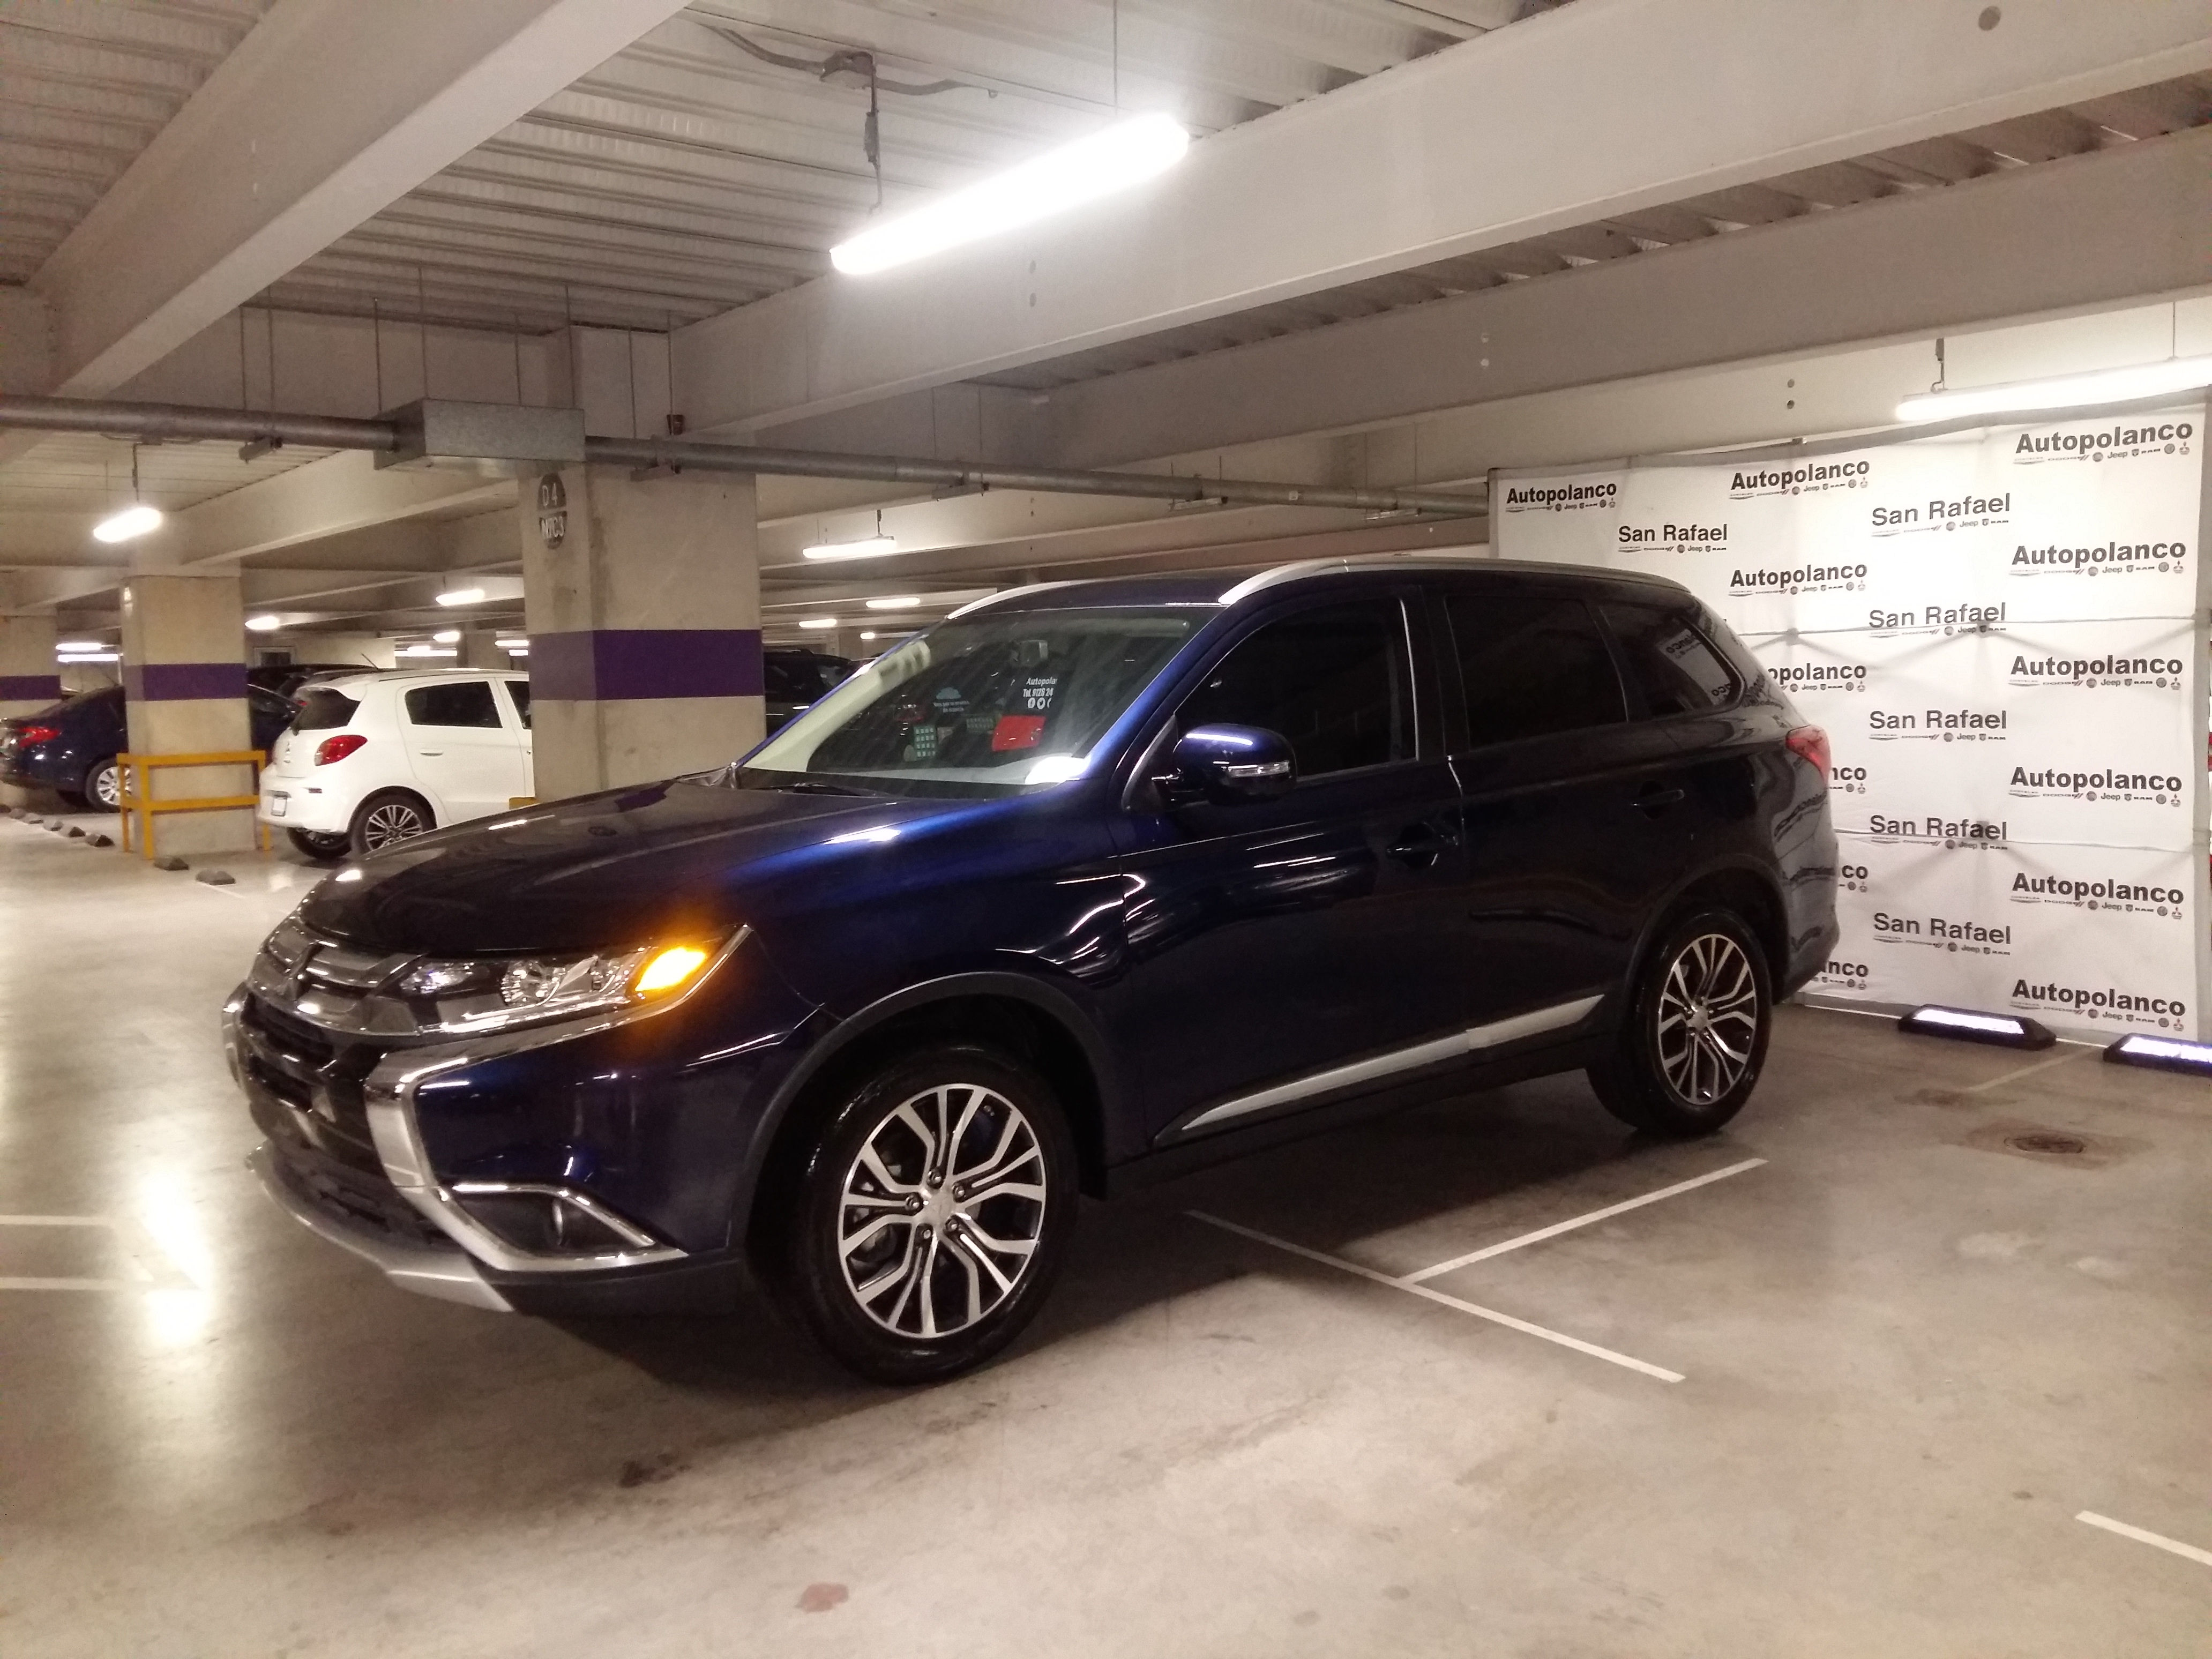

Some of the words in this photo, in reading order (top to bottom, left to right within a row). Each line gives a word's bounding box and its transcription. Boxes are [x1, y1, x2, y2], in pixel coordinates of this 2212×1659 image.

[2015, 423, 2193, 454] Autopolanco
[1731, 461, 1870, 490] Autopolanco
[1506, 483, 1617, 505] Autopolanco
[1872, 507, 1918, 526] San
[1929, 492, 2010, 520] Rafael
[1619, 526, 1655, 542] San
[1663, 524, 1727, 541] Rafael
[2012, 542, 2186, 568] Autopolanco
[1730, 564, 1867, 588] Autopolanco
[1869, 610, 1915, 627] San
[1925, 602, 2006, 624] Rafael
[2011, 655, 2183, 680] Autopolanco
[2101, 678, 2121, 686] Jeep
[1870, 711, 1915, 729] San
[1926, 709, 2006, 729] Rafael
[2011, 767, 2182, 793] Autopolanco
[1870, 814, 1916, 834] San
[1927, 817, 2007, 840] Rafael
[2012, 873, 2184, 904] Autopolanco
[1874, 913, 1920, 935] San
[1931, 918, 2011, 944] Rafael
[2012, 980, 2186, 1016] Autopolanco
